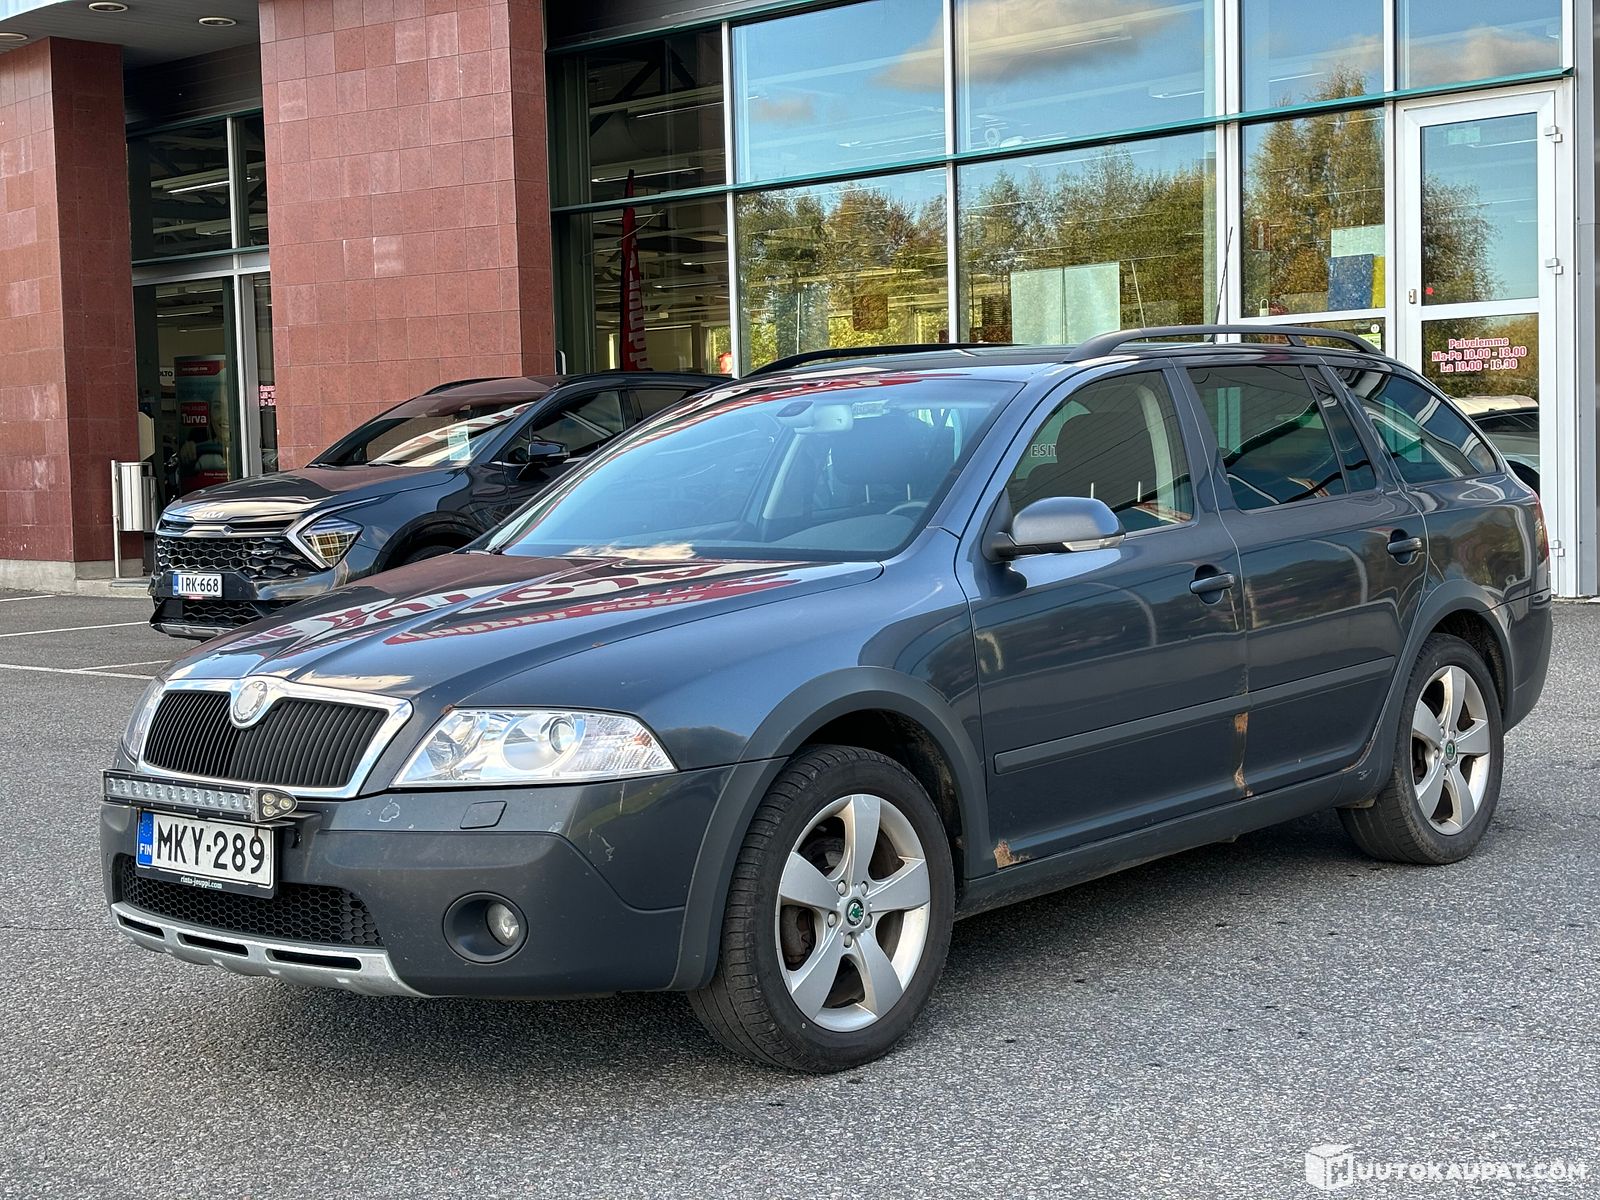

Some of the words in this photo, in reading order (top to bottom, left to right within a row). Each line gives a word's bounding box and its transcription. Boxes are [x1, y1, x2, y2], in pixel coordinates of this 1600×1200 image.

[1449, 338, 1509, 348] Palvelemme
[1432, 351, 1462, 361] Ma-Pe
[1464, 349, 1491, 360] 10.00
[1499, 347, 1527, 358] 18.00
[1441, 362, 1453, 372] La
[1456, 361, 1482, 371] 10.00
[182, 413, 207, 424] Turva
[181, 577, 219, 592] IRK-668
[140, 843, 152, 855] FIN
[157, 821, 265, 875] MKY-289
